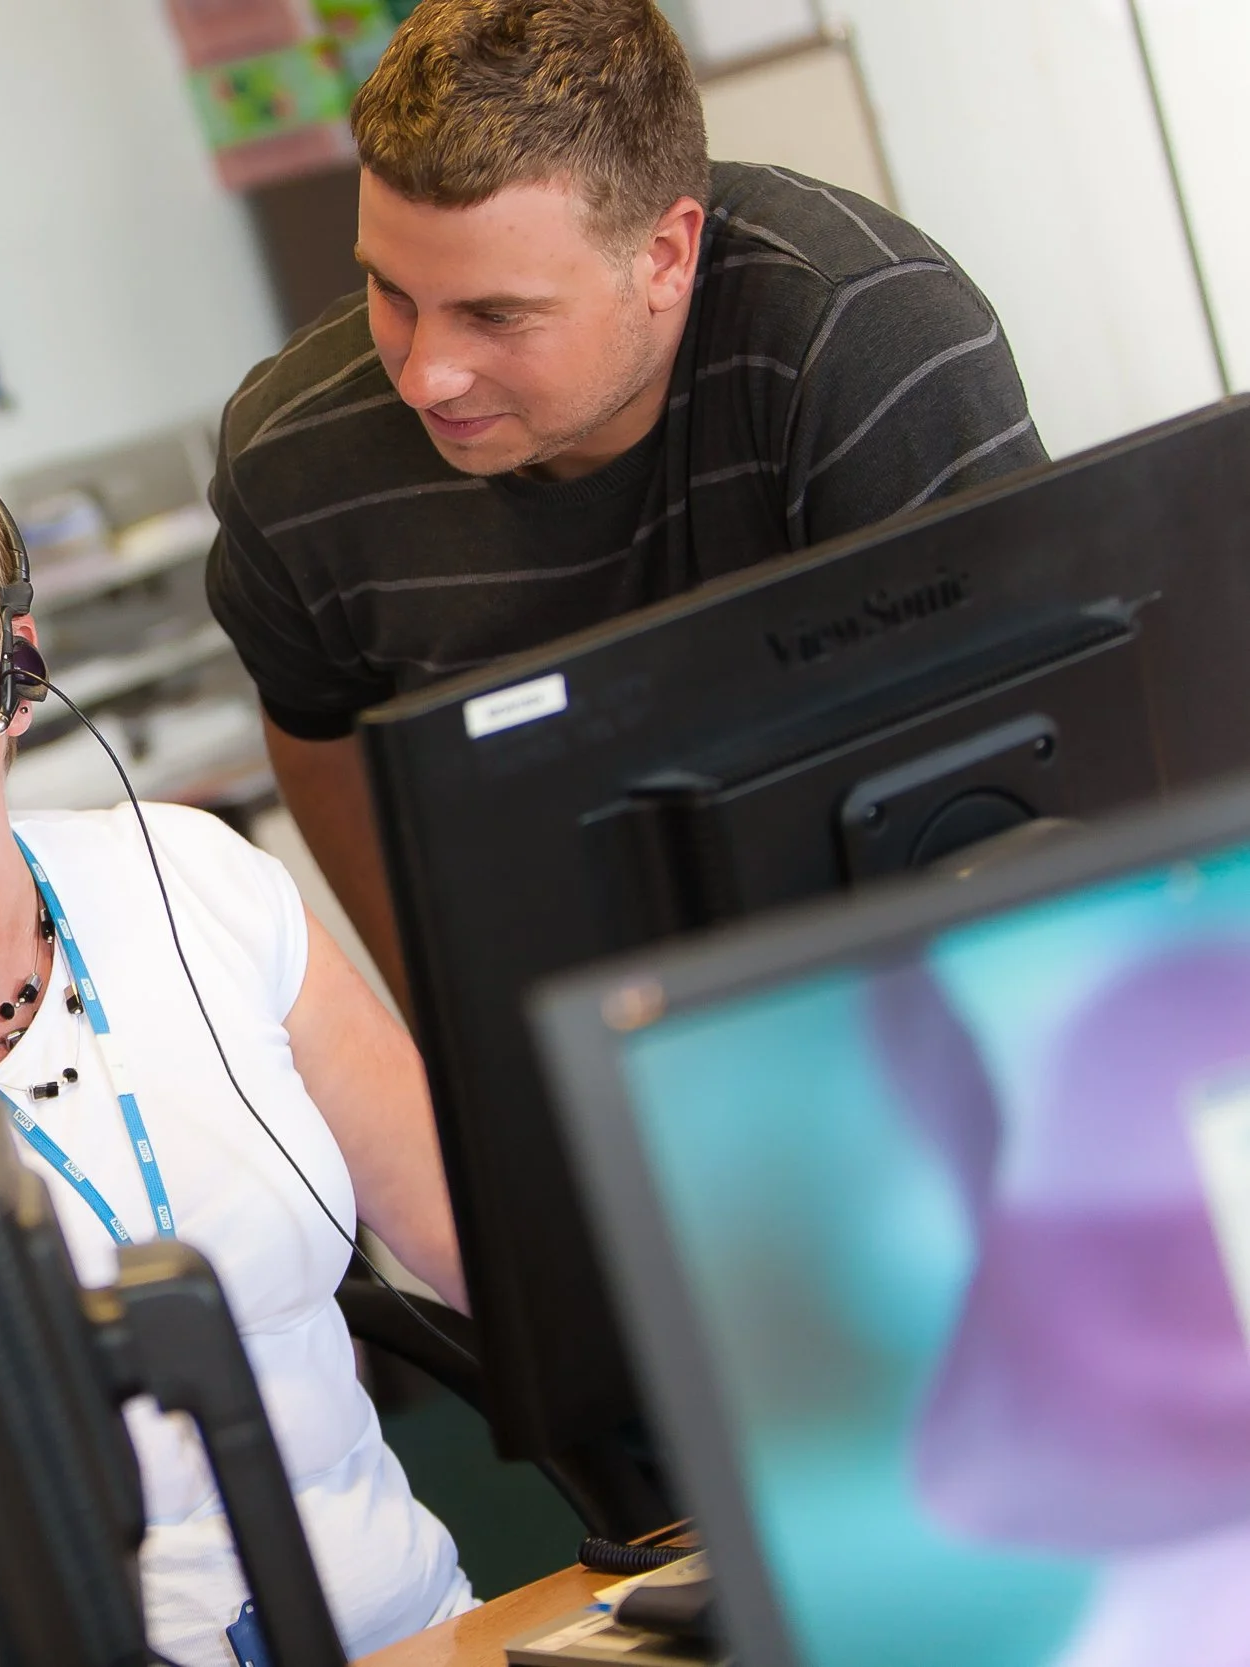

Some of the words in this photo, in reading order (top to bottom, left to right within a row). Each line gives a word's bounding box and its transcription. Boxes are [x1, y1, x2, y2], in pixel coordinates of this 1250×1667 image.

[763, 567, 972, 670] ViewSonic
[15, 1111, 34, 1130] NHS
[139, 1141, 152, 1161] NHS
[65, 1161, 84, 1180] NHS
[159, 1207, 171, 1228] NHS
[112, 1219, 127, 1238] NHS
